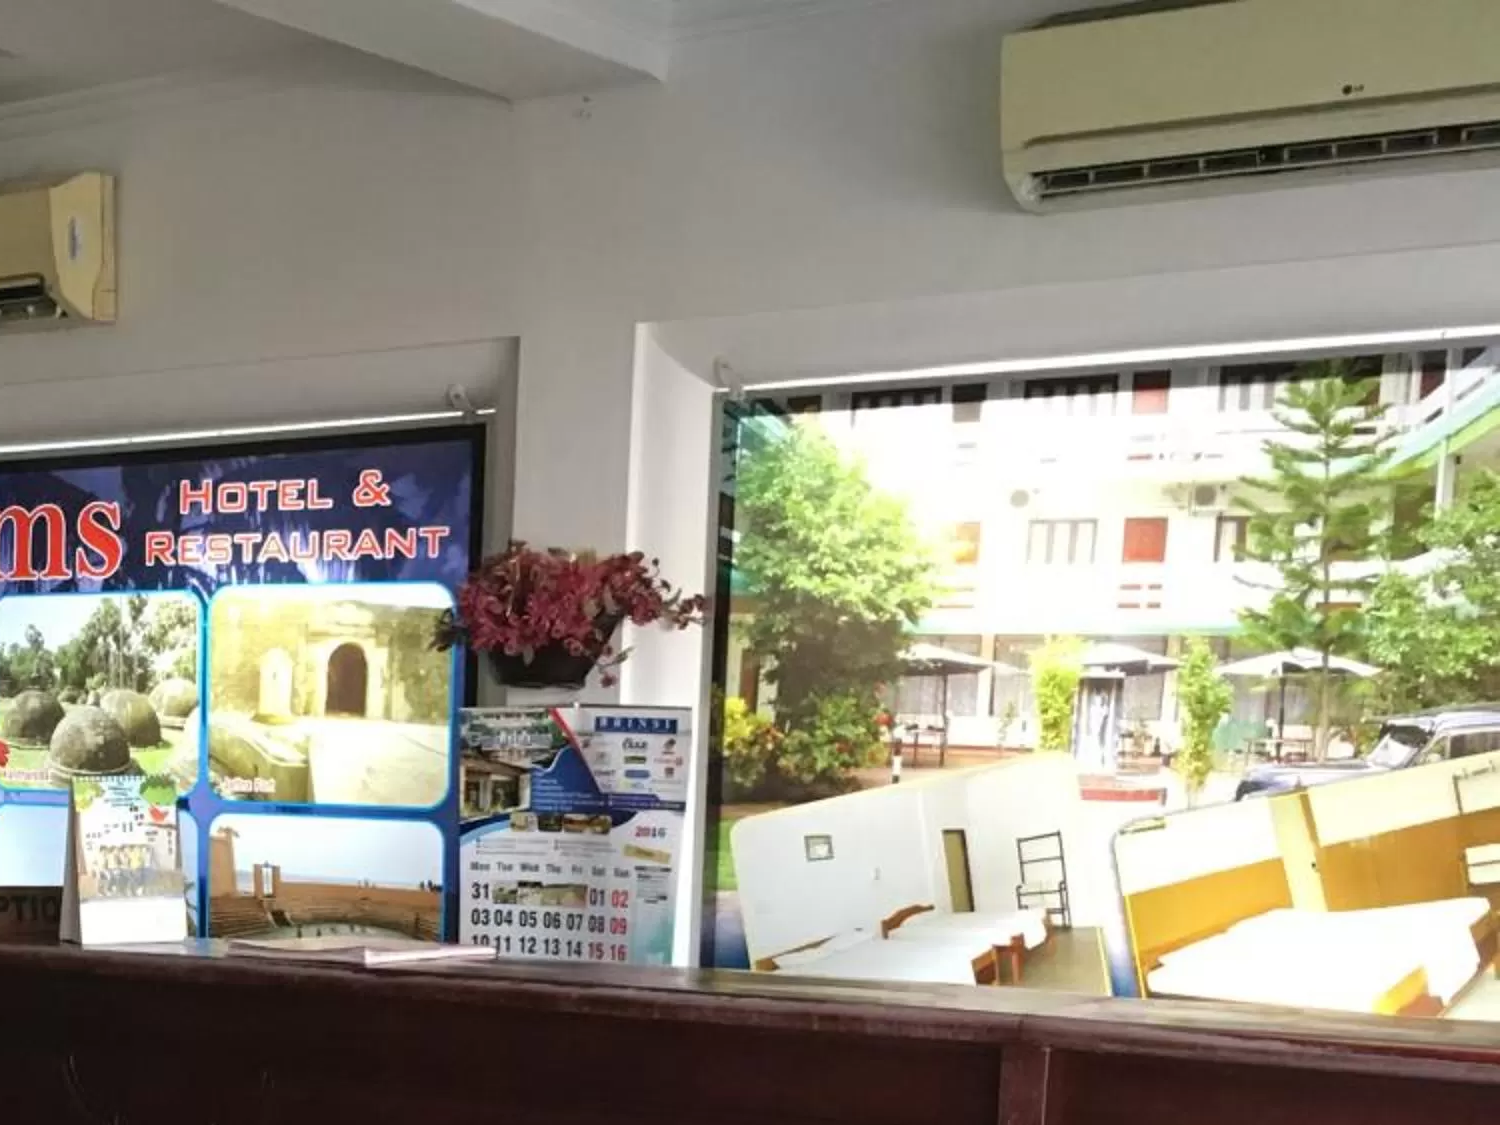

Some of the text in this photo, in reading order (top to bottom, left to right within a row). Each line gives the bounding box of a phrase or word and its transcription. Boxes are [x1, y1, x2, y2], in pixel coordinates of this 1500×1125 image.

[179, 469, 391, 515] HOTEL &
[145, 525, 450, 567] RESTAURANT
[471, 881, 630, 909] 31 01 02
[471, 907, 627, 935] 03 04 05 06 07 08 09
[494, 934, 511, 953] 11
[518, 936, 537, 955] 12
[542, 938, 560, 956] 13
[566, 940, 583, 958] 14
[588, 941, 605, 960] 15
[610, 943, 626, 961] 16
